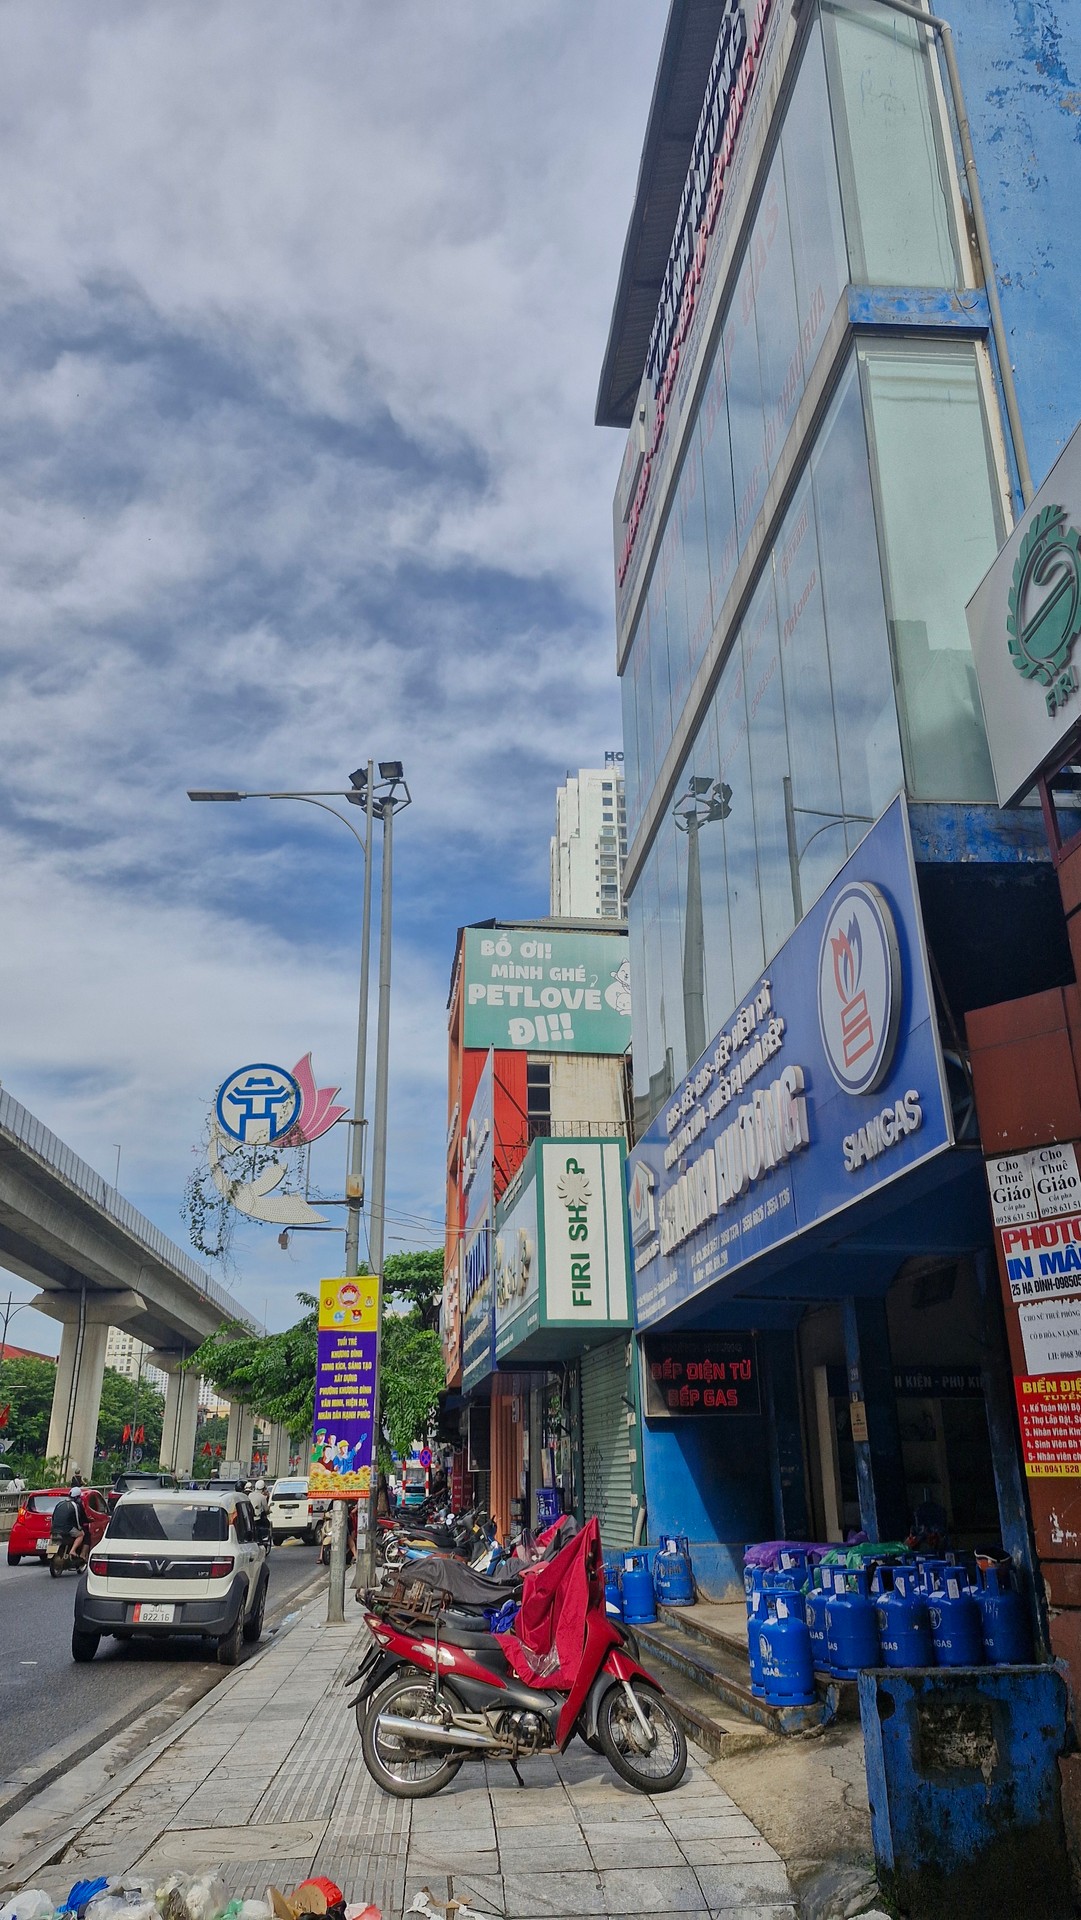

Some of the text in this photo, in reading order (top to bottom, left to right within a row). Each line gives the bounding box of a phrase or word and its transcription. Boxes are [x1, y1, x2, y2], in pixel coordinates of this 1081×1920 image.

[690, 8, 747, 233] HƯƠNG
[705, 152, 725, 235] BẾP
[724, 46, 755, 167] HỒNG
[739, 175, 781, 330] GAS
[782, 566, 817, 649] Paloma
[481, 933, 552, 959] BỐ ƠI!
[491, 961, 586, 982] MÌNH GHÉ
[468, 983, 602, 1011] PETLOVE
[508, 1012, 574, 1045] ĐI!!
[762, 1011, 784, 1063] BẾP
[714, 1030, 732, 1073] BẾP
[714, 1065, 810, 1207] HƯƠNG
[842, 1089, 923, 1173] SIAMGAS
[1040, 1150, 1062, 1162] Cho
[997, 1161, 1018, 1172] Cho
[1039, 1160, 1068, 1176] Thuê
[996, 1171, 1024, 1185] Thuê
[1037, 1175, 1077, 1195] Giáo
[993, 1185, 1031, 1204] Giáo
[996, 1211, 1037, 1224] 0928 631 511
[1041, 1206, 1058, 1216] 0928
[1060, 1203, 1071, 1212] 631
[1007, 1241, 1081, 1281] IN MẦ
[571, 1253, 593, 1307] FIRI
[1012, 1284, 1021, 1296] 25
[1022, 1282, 1033, 1296] HẠ
[651, 1357, 751, 1384] BẾP ĐIỆN TỪ
[1022, 1377, 1081, 1394] BIỂN ĐIỆ
[668, 1385, 737, 1407] BẾP GAS
[1022, 1404, 1029, 1413] 1.
[1030, 1402, 1039, 1412] Kế
[1040, 1403, 1056, 1412] Toán
[1023, 1416, 1030, 1425] 2.
[1025, 1428, 1032, 1437] 3.
[1033, 1427, 1051, 1437] Nhân
[1052, 1427, 1067, 1436] Viên
[1026, 1440, 1034, 1449] 4.
[1034, 1440, 1050, 1449] Sinh
[1051, 1439, 1067, 1448] Viên
[1037, 1452, 1055, 1461] Nhân
[1031, 1465, 1043, 1473] LH:
[1044, 1465, 1062, 1473] 0941
[142, 1613, 170, 1622] 822.16
